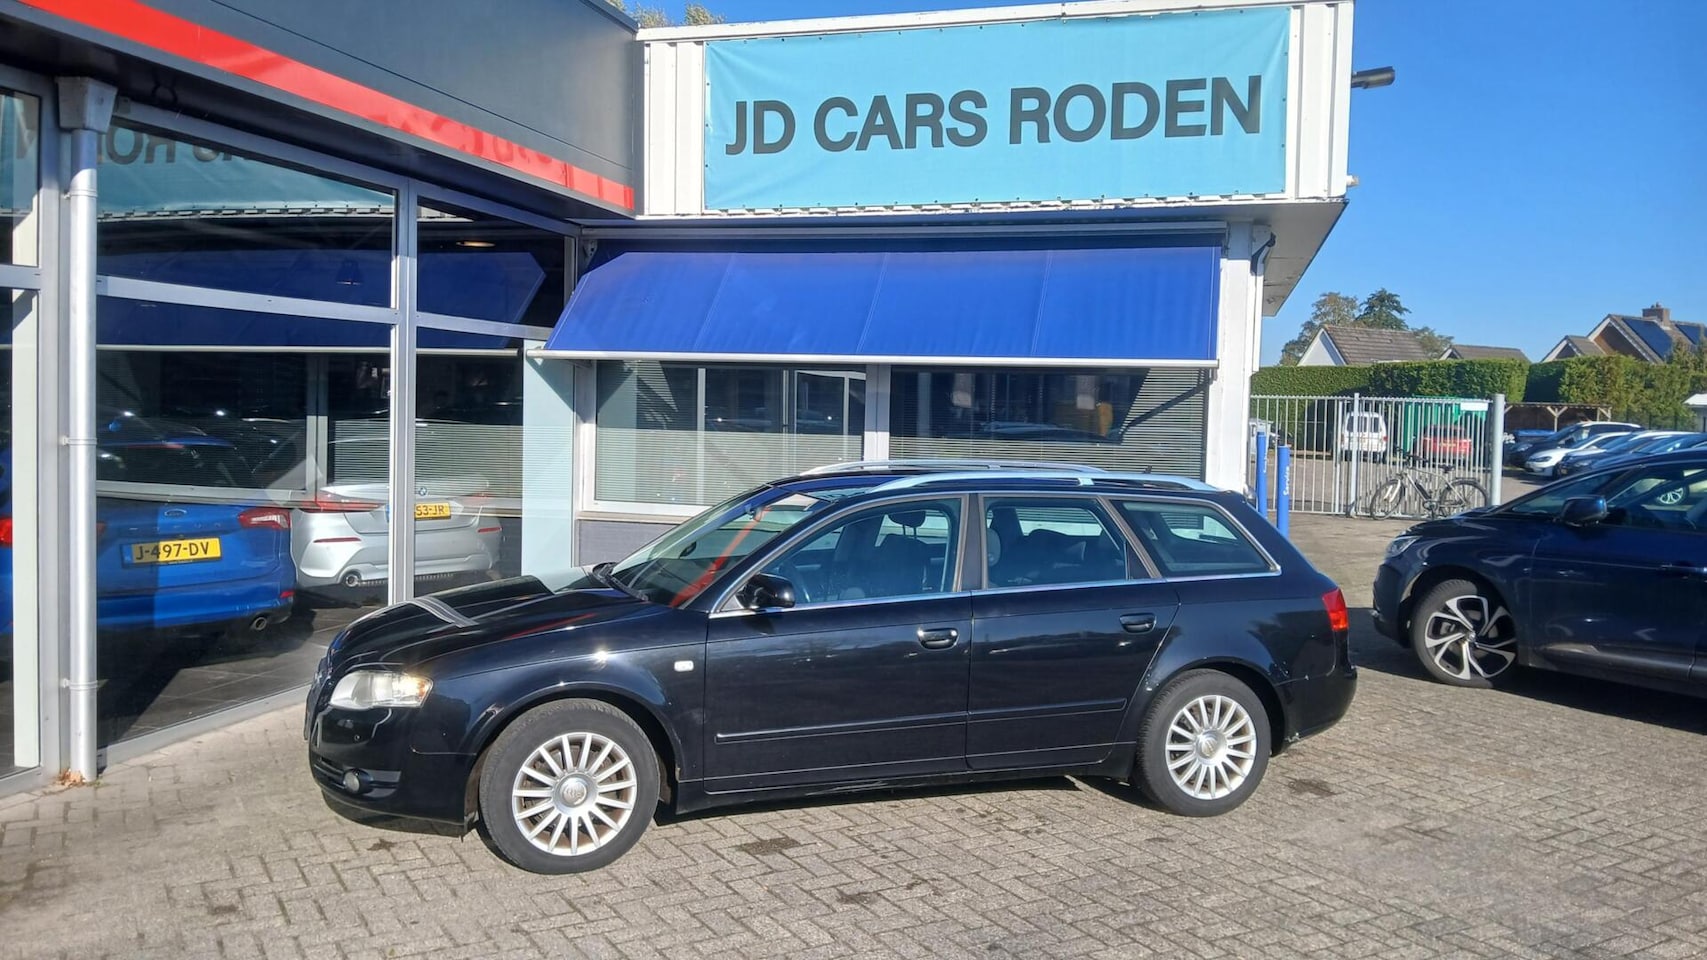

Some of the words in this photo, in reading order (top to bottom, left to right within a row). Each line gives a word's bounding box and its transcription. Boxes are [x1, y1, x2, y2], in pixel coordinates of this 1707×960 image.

[725, 99, 796, 156] JD
[813, 89, 988, 152] CARS
[1009, 75, 1262, 145] RODEN
[136, 541, 209, 561] J-497-DV
